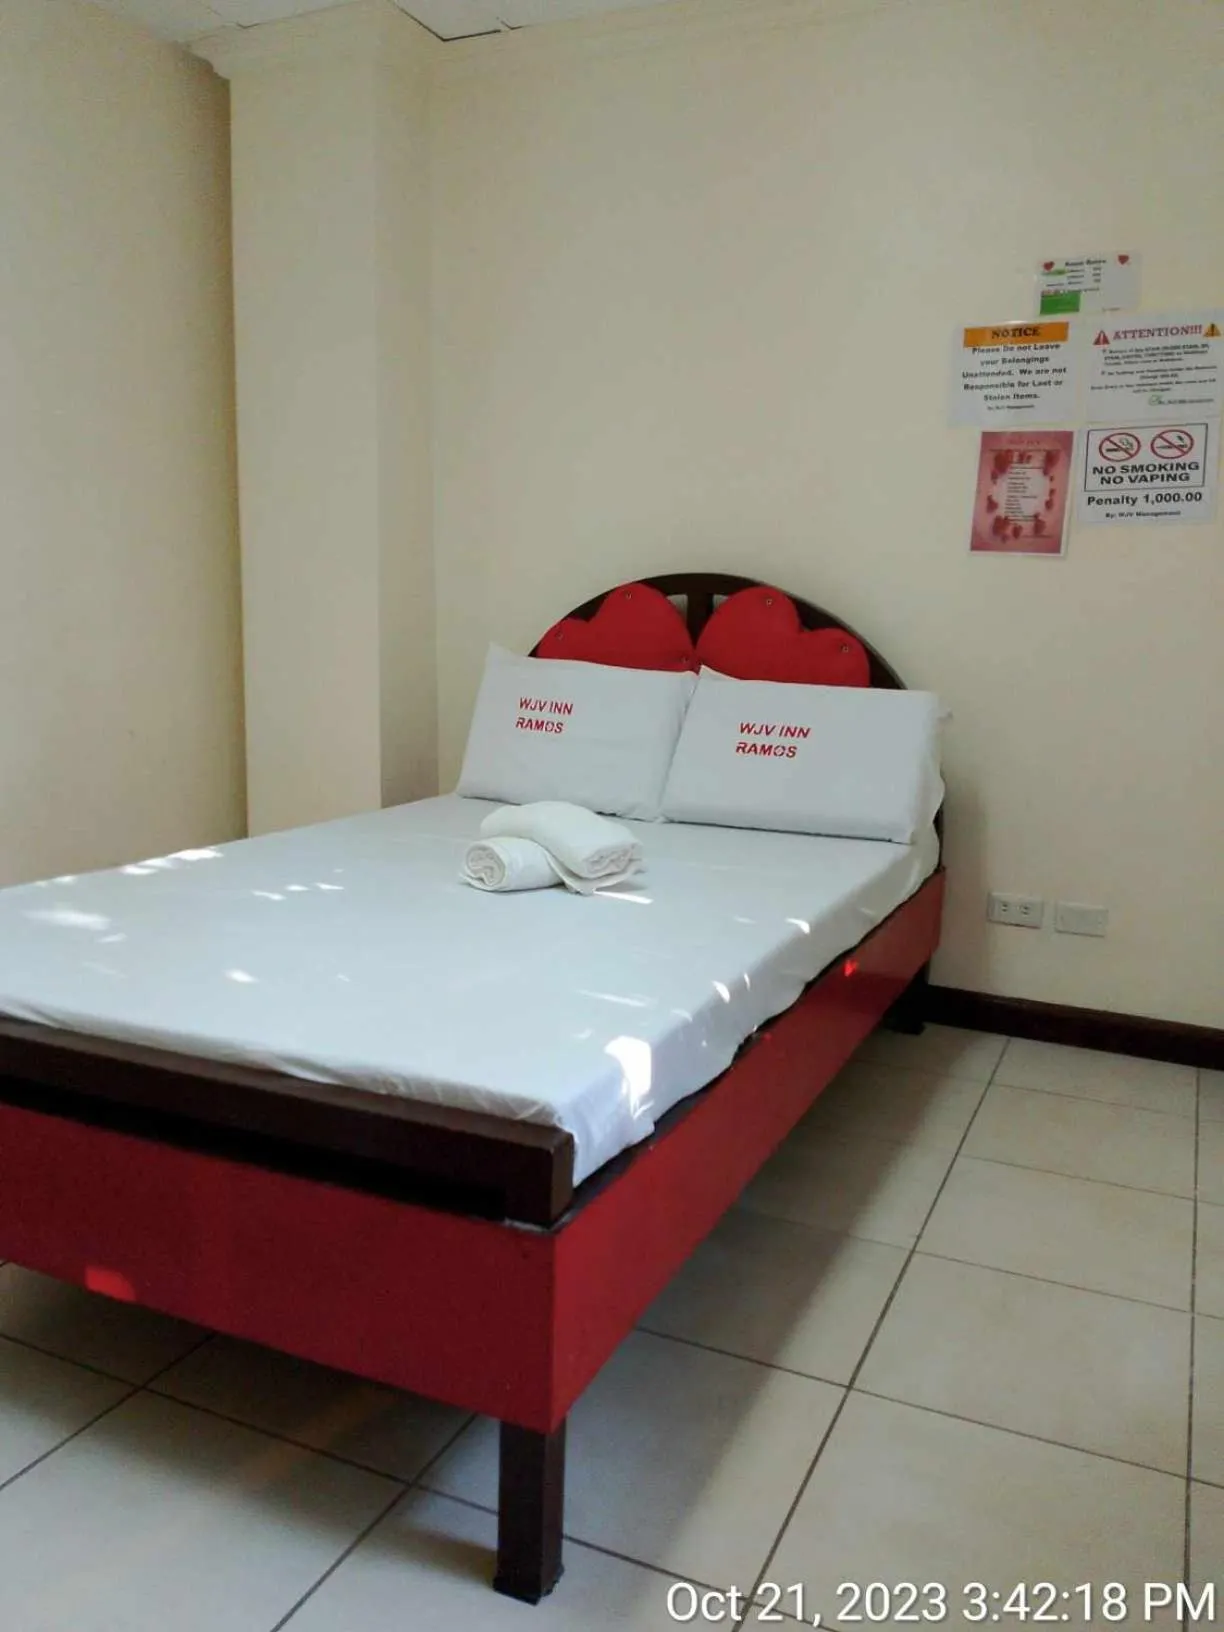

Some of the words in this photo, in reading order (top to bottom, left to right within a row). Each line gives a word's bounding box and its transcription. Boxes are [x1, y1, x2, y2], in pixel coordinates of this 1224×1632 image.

[992, 327, 1040, 339] NOTICE
[1113, 324, 1202, 340] ATTENTION!!!
[1001, 356, 1049, 364] Belongings
[964, 381, 1015, 391] Responsible
[1092, 465, 1116, 474] NO
[1120, 461, 1199, 474] SMOKING
[1100, 475, 1124, 485] NO
[1128, 472, 1190, 484] VAPING
[1087, 495, 1138, 506] Penalty
[1143, 492, 1202, 505] 1,000.00
[519, 697, 548, 713] WJV
[549, 699, 574, 716] INN
[516, 717, 564, 734] RAMOS
[739, 722, 777, 737] WJV
[779, 724, 811, 739] INN
[736, 741, 798, 759] RAMOS
